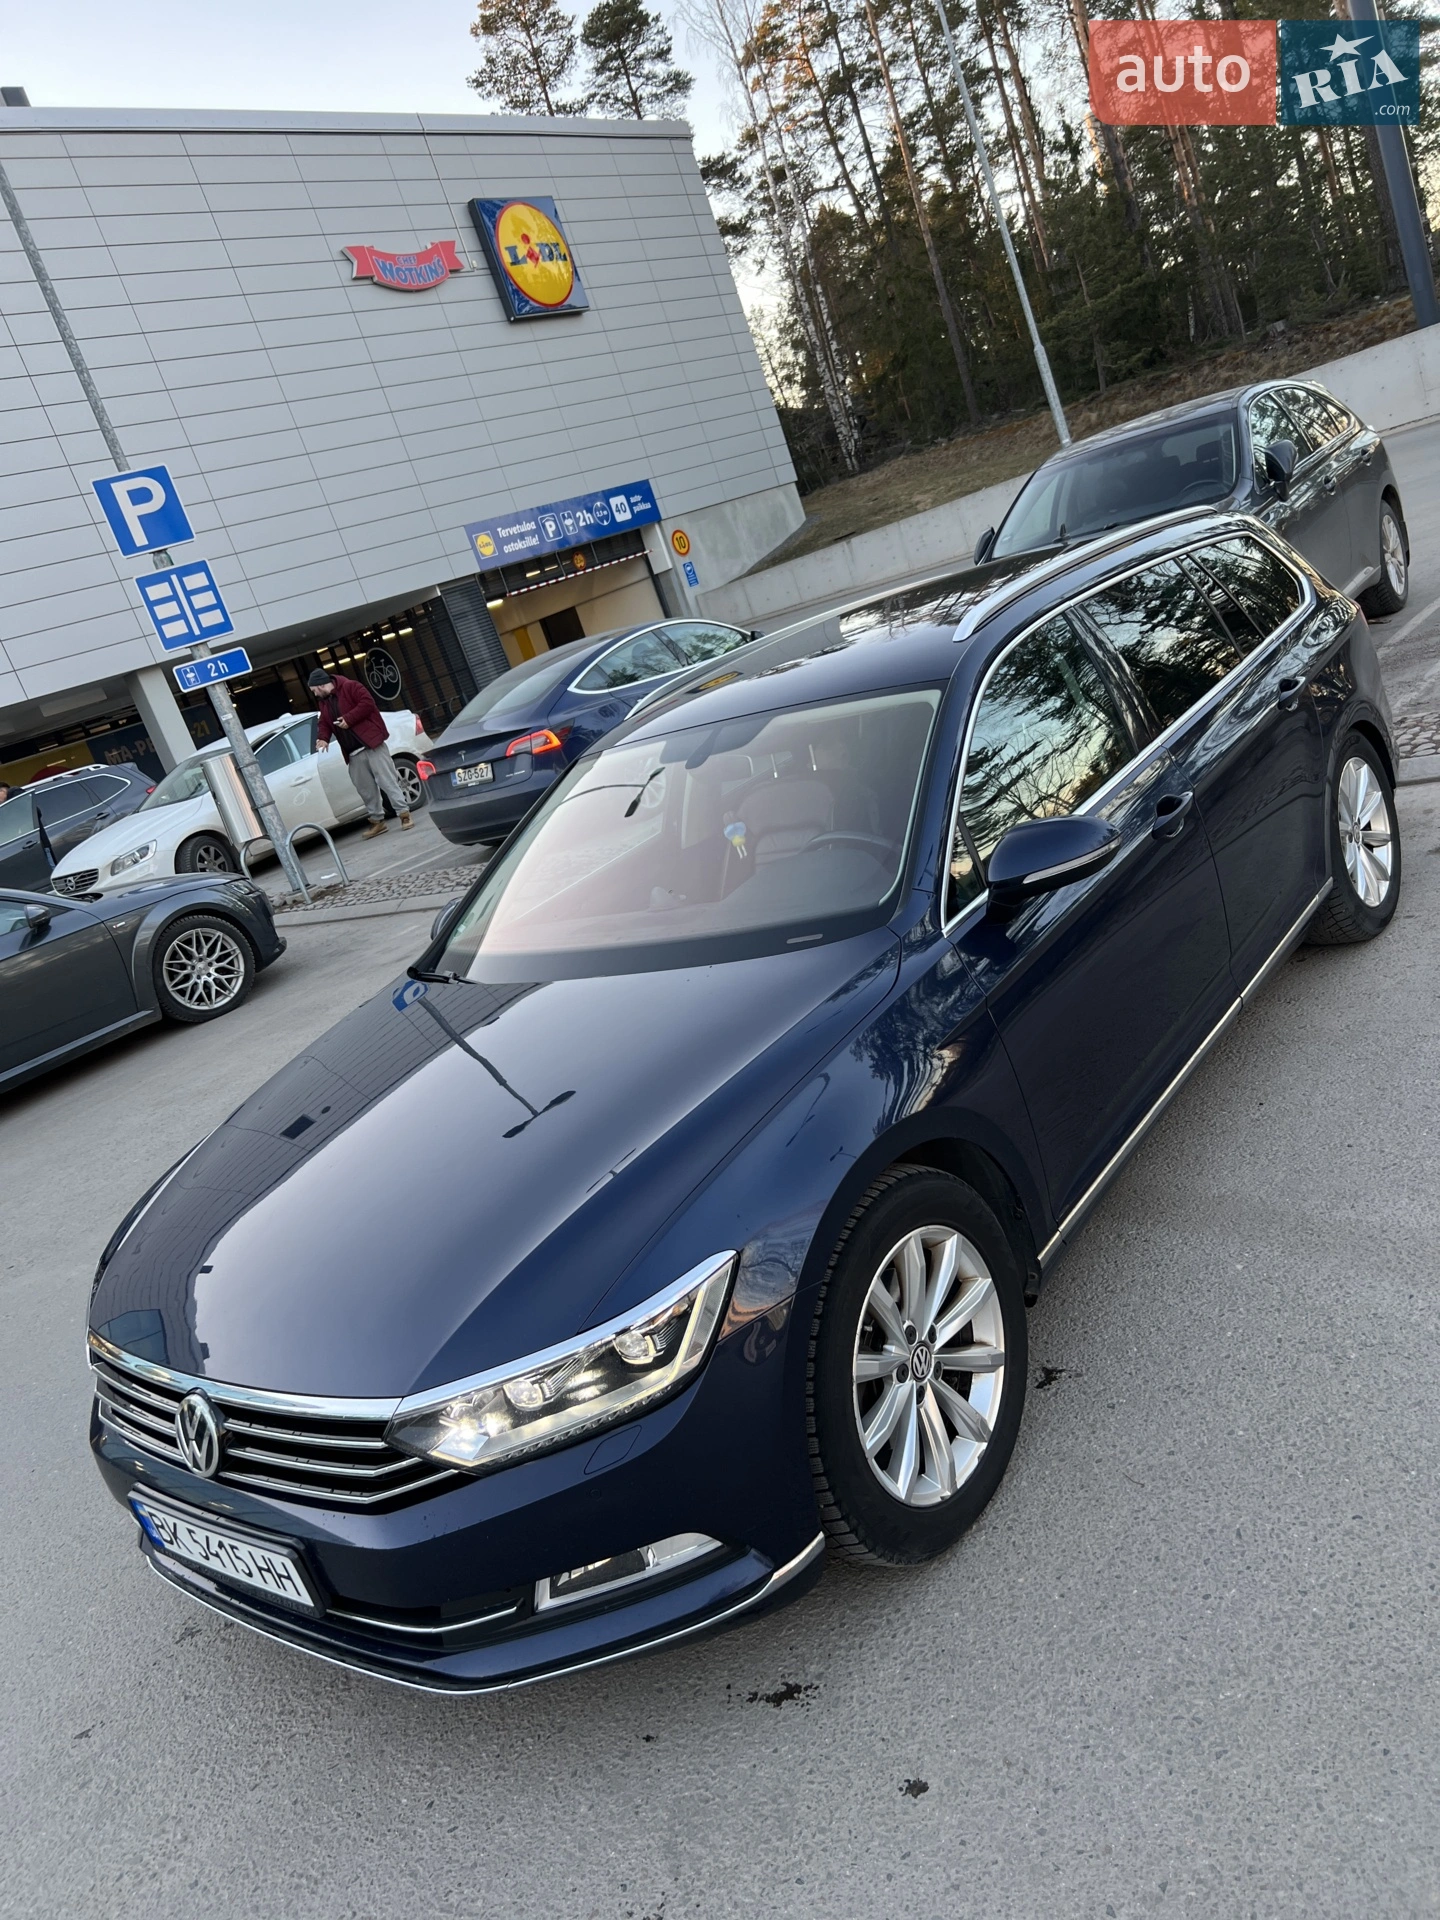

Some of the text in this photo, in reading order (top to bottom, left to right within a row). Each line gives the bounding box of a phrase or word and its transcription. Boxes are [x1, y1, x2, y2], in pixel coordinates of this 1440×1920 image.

[396, 255, 417, 265] CHEF
[505, 233, 567, 269] LIDL
[373, 254, 445, 285] WOTKIN'S
[110, 476, 166, 547] P
[615, 502, 626, 515] 40
[576, 512, 594, 527] 2h
[497, 520, 536, 538] Tervetuloa
[503, 536, 540, 554] ostoksille!
[675, 535, 686, 550] 10
[457, 767, 489, 782] SZG-527
[149, 1513, 193, 1554] BK
[187, 1528, 253, 1578] 5415
[249, 1551, 301, 1597] HH
